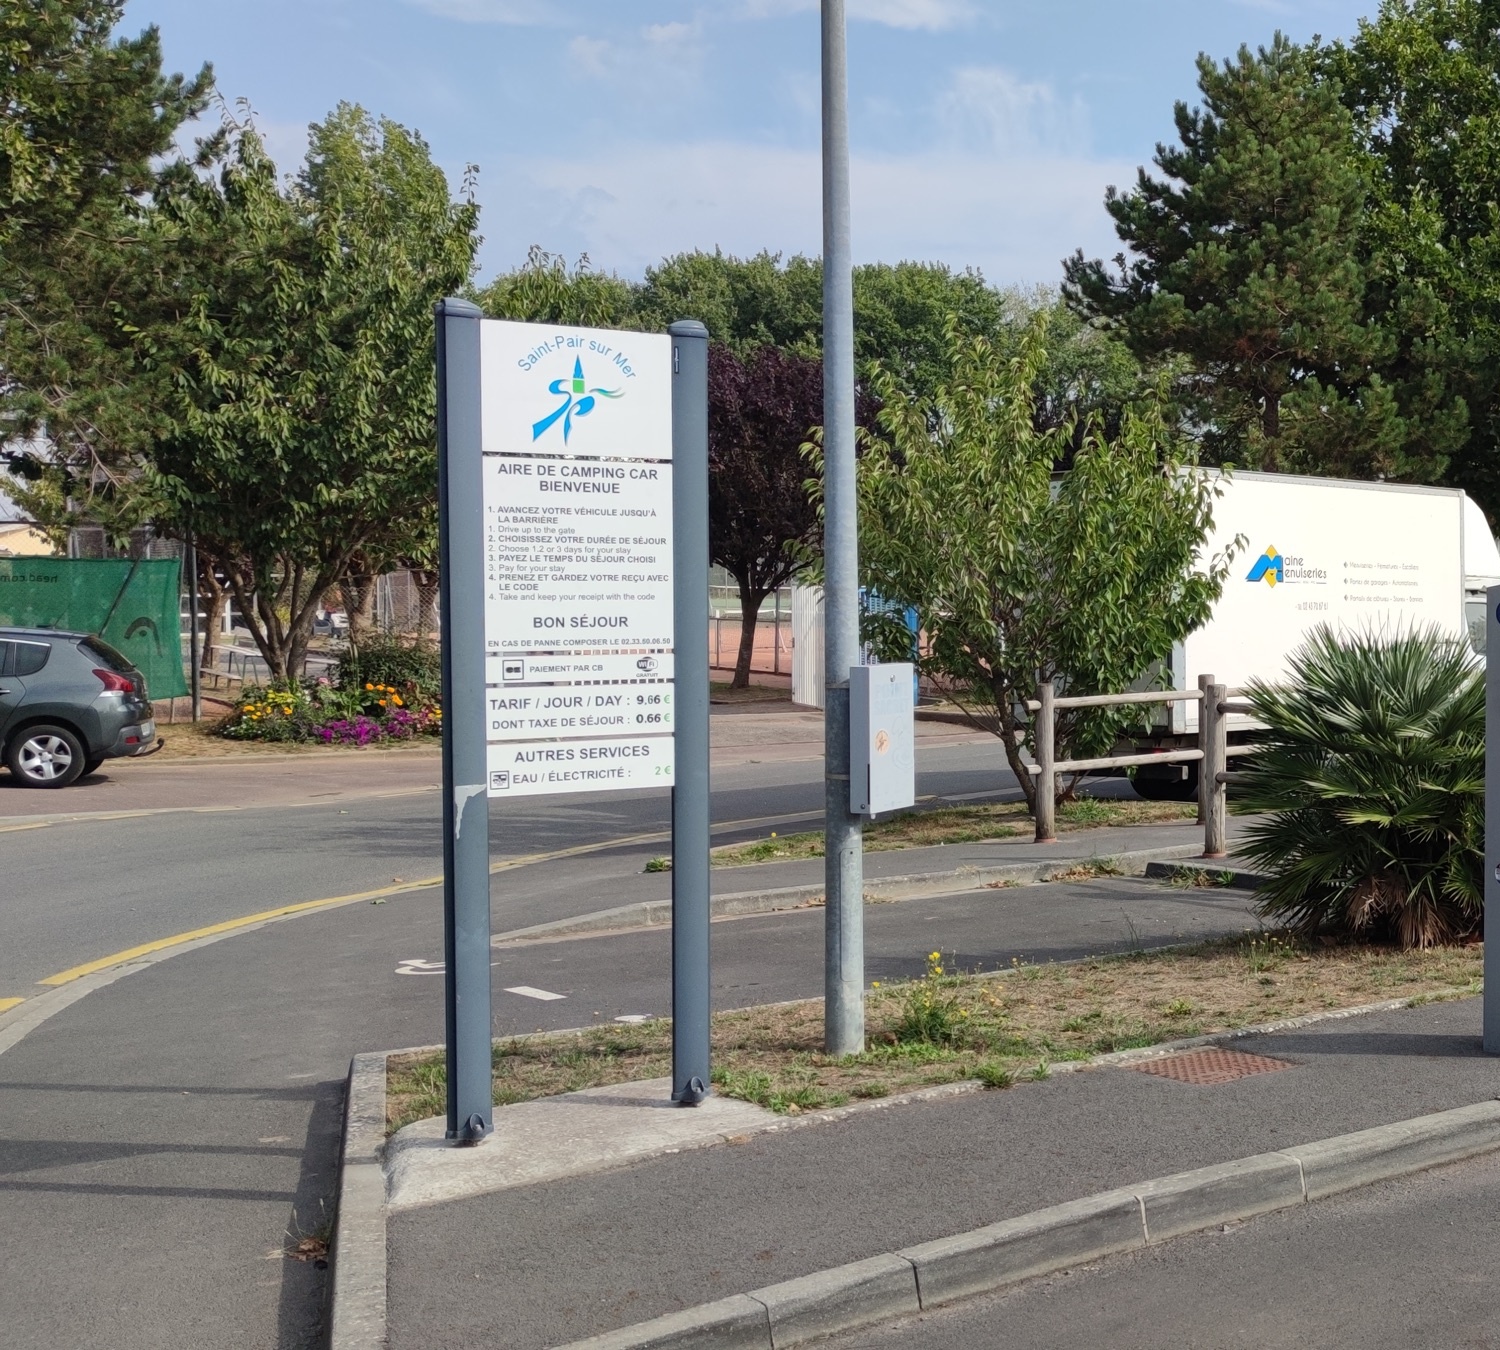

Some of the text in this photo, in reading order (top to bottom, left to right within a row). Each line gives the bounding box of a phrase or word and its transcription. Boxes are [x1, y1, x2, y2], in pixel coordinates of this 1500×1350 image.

[518, 335, 636, 378] Saint-Pair sur Mer
[498, 463, 658, 480] AIRE DE CAMPING CAR
[539, 481, 620, 493] BIENVENUE
[498, 506, 539, 514] AVANCEZ
[542, 507, 571, 515] VOTRE
[574, 507, 617, 516] VÉHICULE
[620, 509, 656, 517] JUSQU'À
[512, 515, 558, 524] BARRIÈRE
[498, 535, 552, 543] CHOISISSEZ
[587, 536, 616, 544] DURÉE
[632, 537, 666, 545] SÉJOUR
[564, 546, 582, 555] days
[591, 554, 625, 563] SÉJOUR
[499, 565, 515, 573] Pay
[549, 565, 565, 573] stay
[621, 575, 645, 583] REÇU
[538, 593, 557, 602] keep
[578, 593, 604, 602] receipt
[533, 614, 628, 628] BON SÉJOUR
[490, 699, 531, 710] TARIF
[544, 697, 583, 709] JOUR
[595, 695, 622, 706] DAY
[664, 694, 670, 703] €
[492, 720, 525, 729] DONT
[529, 718, 557, 728] TAXE
[561, 718, 576, 727] DE
[580, 715, 624, 725] SÉJOUR
[636, 714, 661, 723] 0.66
[664, 713, 670, 722] €
[515, 745, 650, 762] AUTRES SERVICES
[513, 774, 538, 783] EAU
[549, 767, 624, 782] ÉLECTRICITÉ
[655, 767, 661, 775] 2
[664, 766, 671, 774] €
